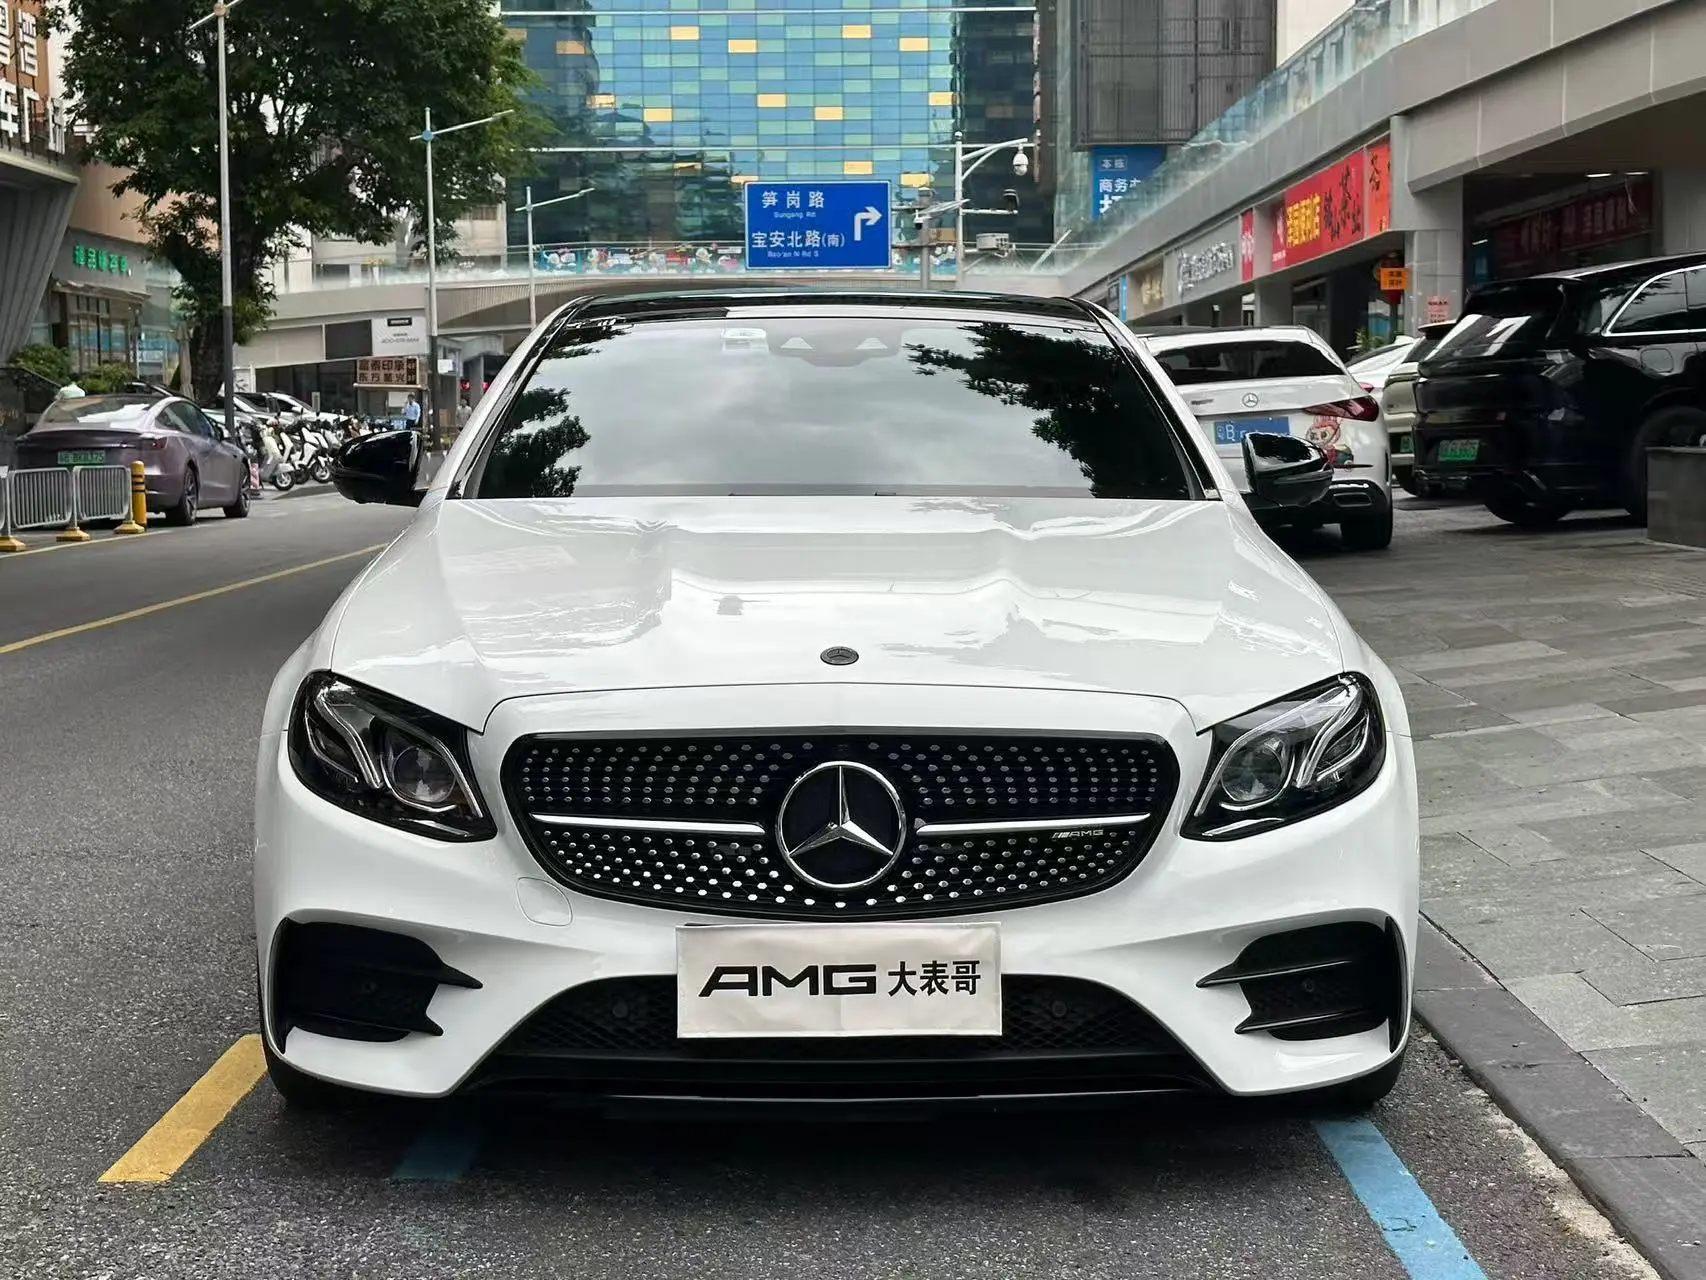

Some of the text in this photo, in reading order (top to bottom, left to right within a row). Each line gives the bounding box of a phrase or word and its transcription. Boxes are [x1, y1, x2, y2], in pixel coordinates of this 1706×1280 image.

[762, 190, 825, 209] 笋岗路
[751, 230, 846, 249] 宝安北路(南)
[1066, 829, 1104, 839] AMG
[698, 960, 982, 997] AMG 大表哥
